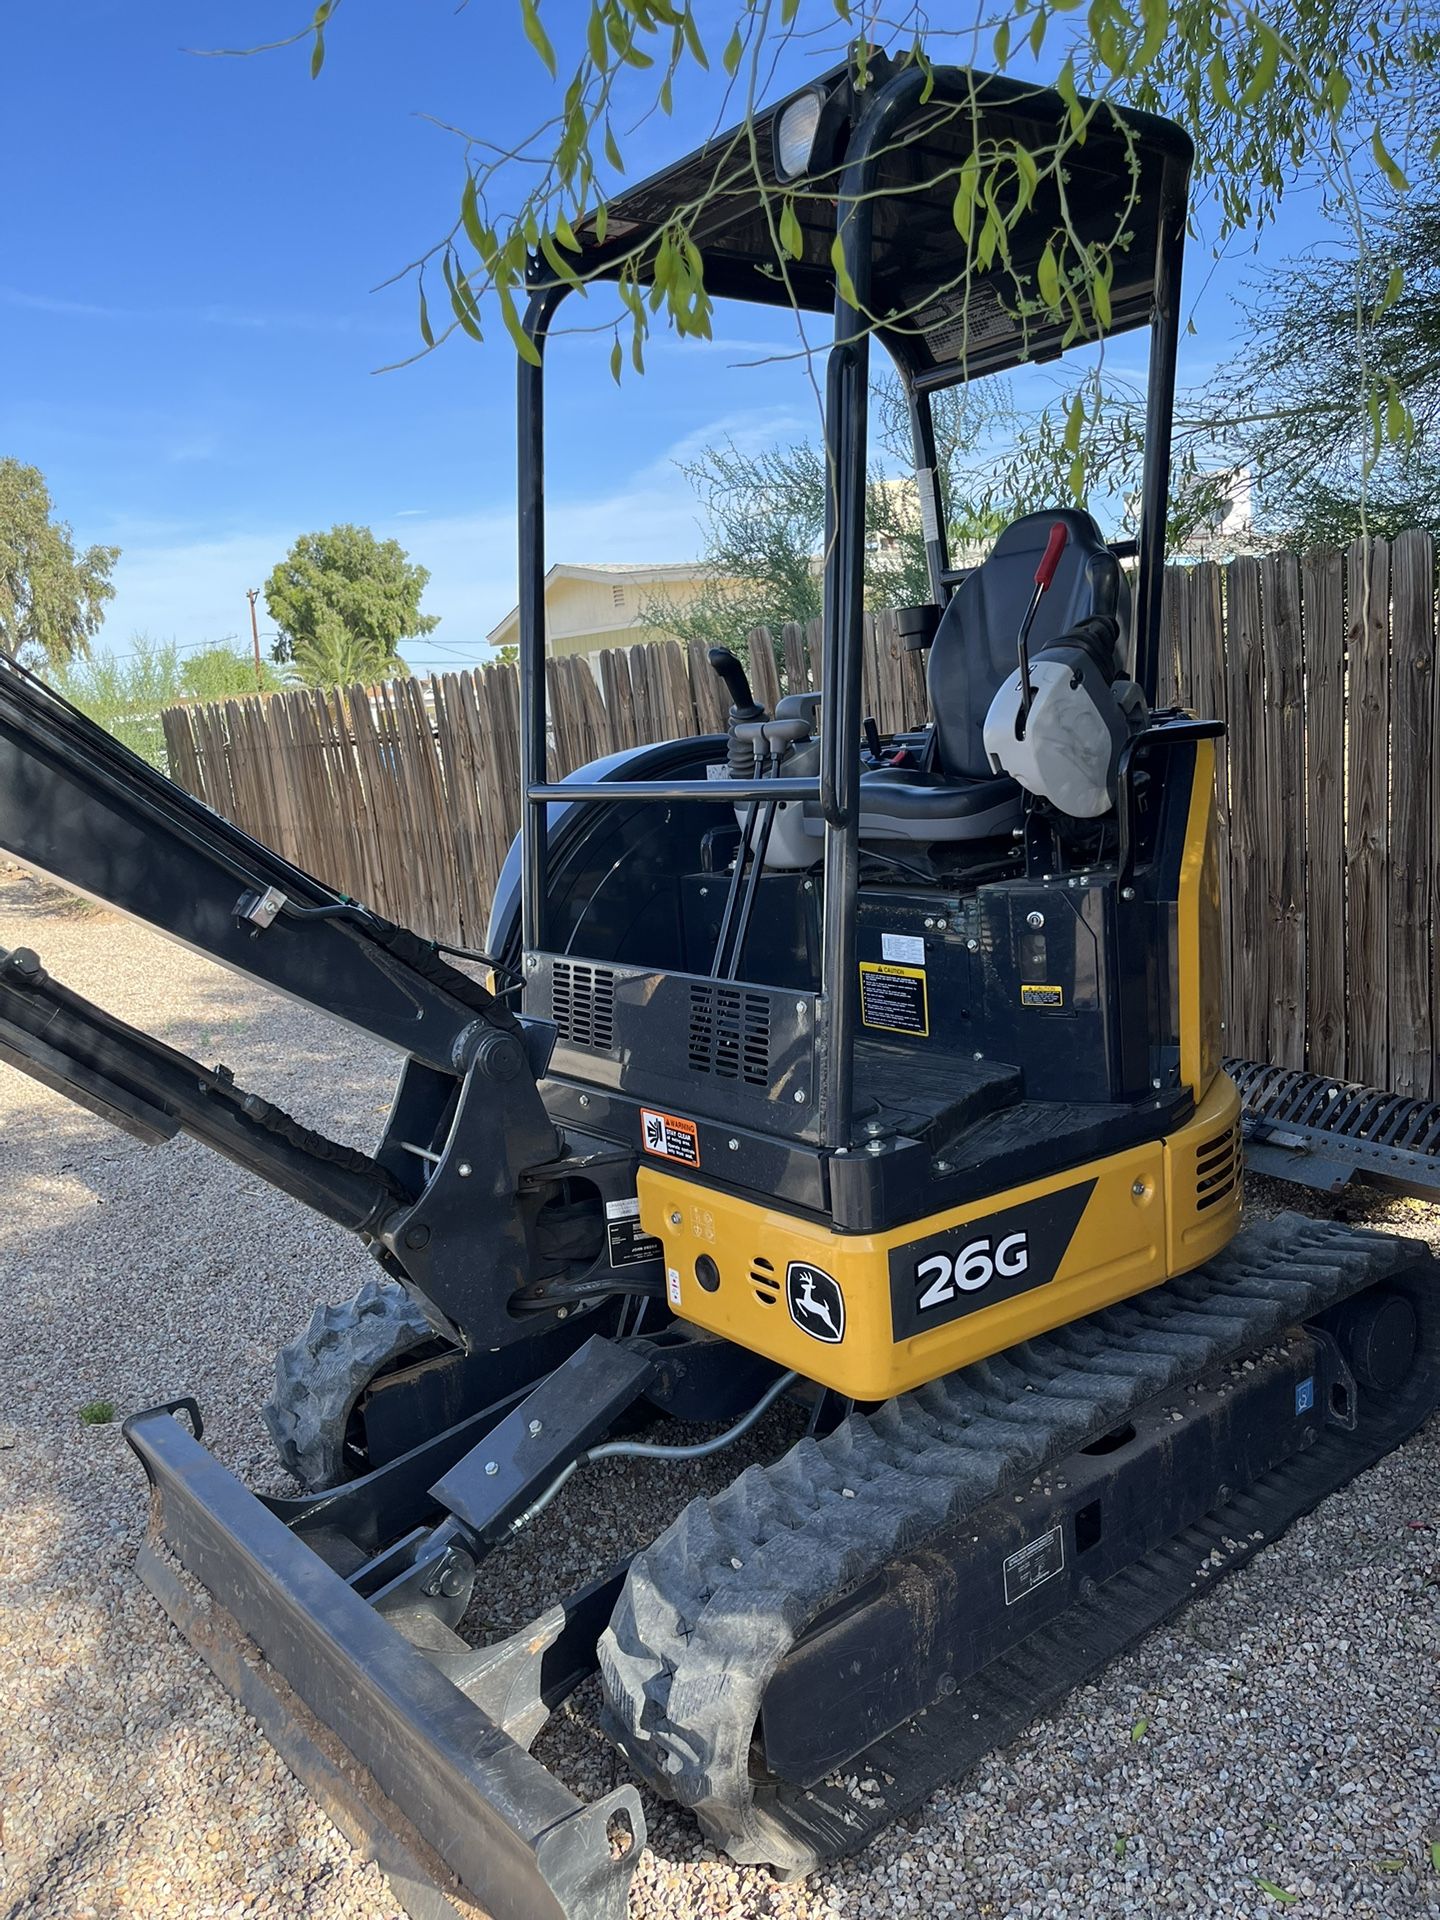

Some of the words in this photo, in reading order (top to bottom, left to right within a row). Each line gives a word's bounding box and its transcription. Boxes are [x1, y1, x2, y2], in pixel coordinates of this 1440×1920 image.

[884, 967, 905, 975] CAUTION
[671, 1120, 694, 1132] WARNING
[666, 1128, 676, 1136] STAY
[677, 1132, 691, 1141] CLEAR
[917, 1232, 1028, 1309] 26G
